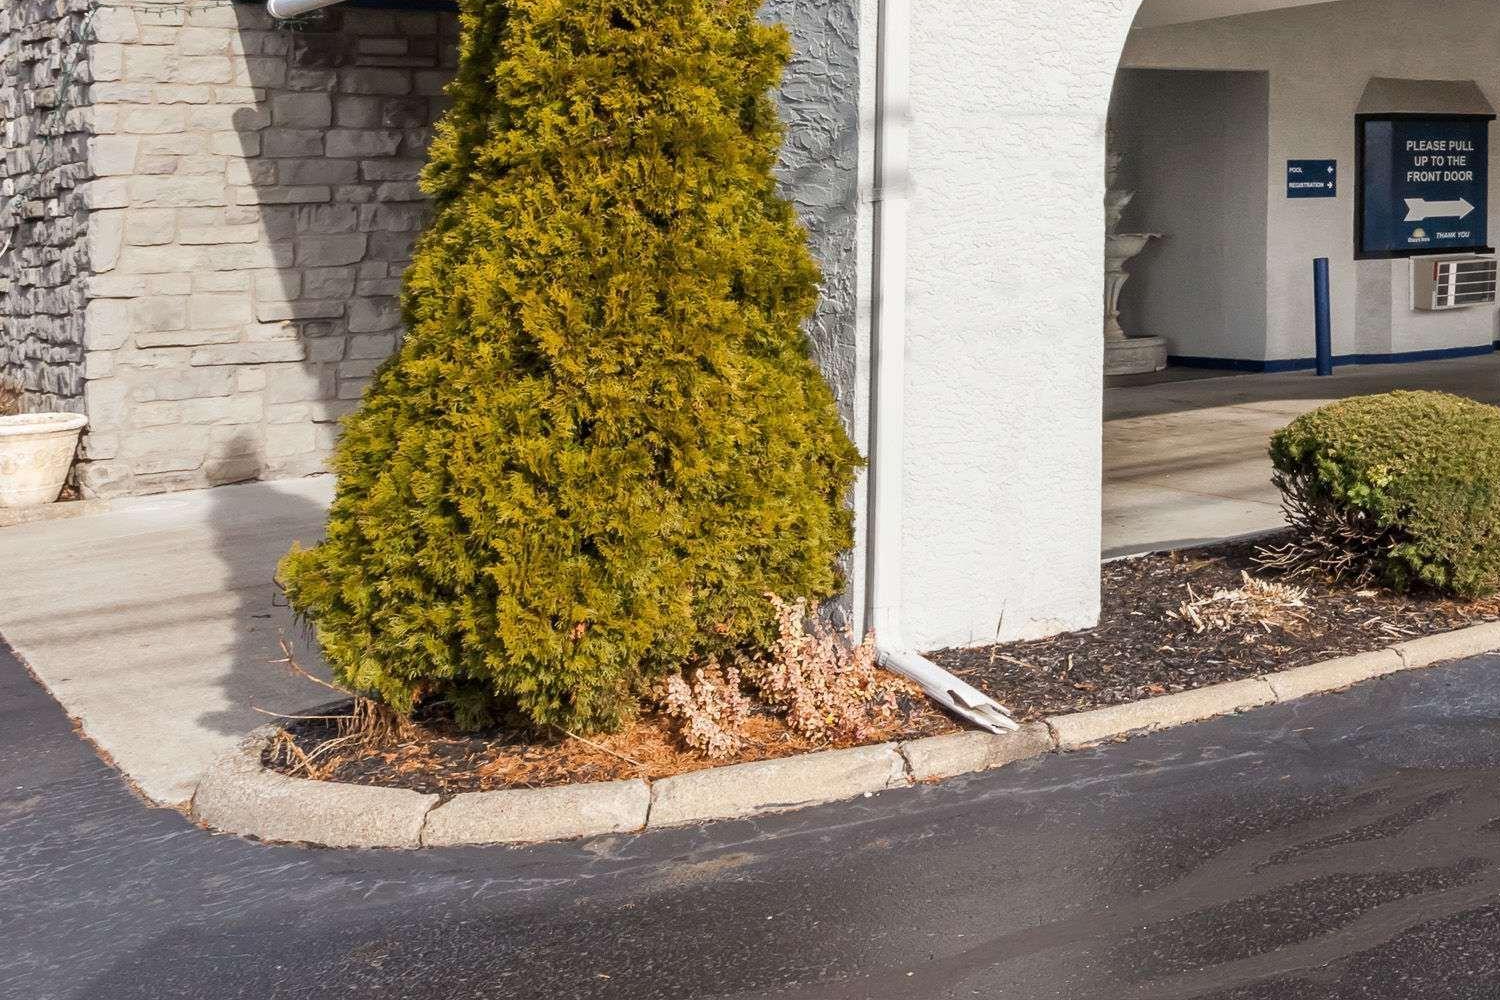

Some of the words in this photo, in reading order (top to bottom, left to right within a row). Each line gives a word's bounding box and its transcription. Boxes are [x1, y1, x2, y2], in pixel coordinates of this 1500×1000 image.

[1406, 140, 1446, 151] PLEASE
[1449, 140, 1475, 151] PULL
[1414, 155, 1428, 166] UP
[1430, 155, 1444, 166] TO
[1447, 155, 1467, 166] THE
[1407, 170, 1441, 182] FRONT
[1443, 170, 1473, 181] DOOR
[1436, 231, 1456, 239] THANK
